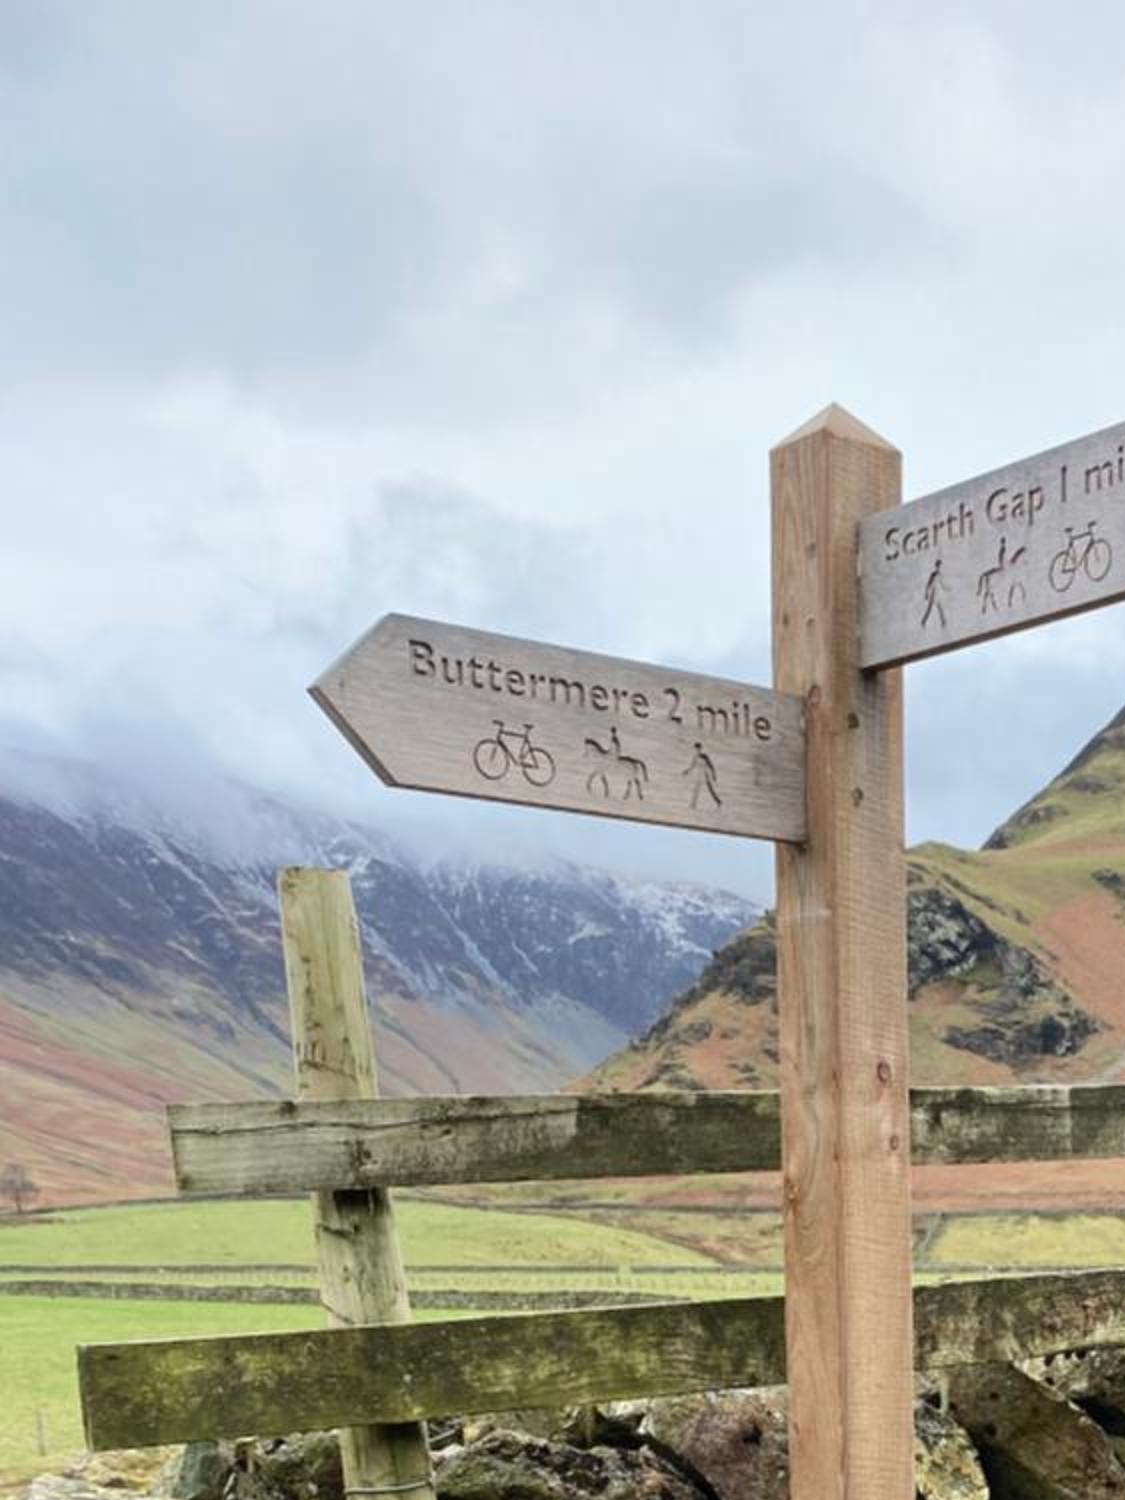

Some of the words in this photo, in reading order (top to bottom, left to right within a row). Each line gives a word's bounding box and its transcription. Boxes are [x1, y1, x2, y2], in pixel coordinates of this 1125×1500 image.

[885, 503, 974, 561] Scarth
[986, 487, 1045, 526] Gap
[408, 639, 650, 718] Buttermere
[663, 687, 683, 724] 2
[696, 701, 772, 741] mile
